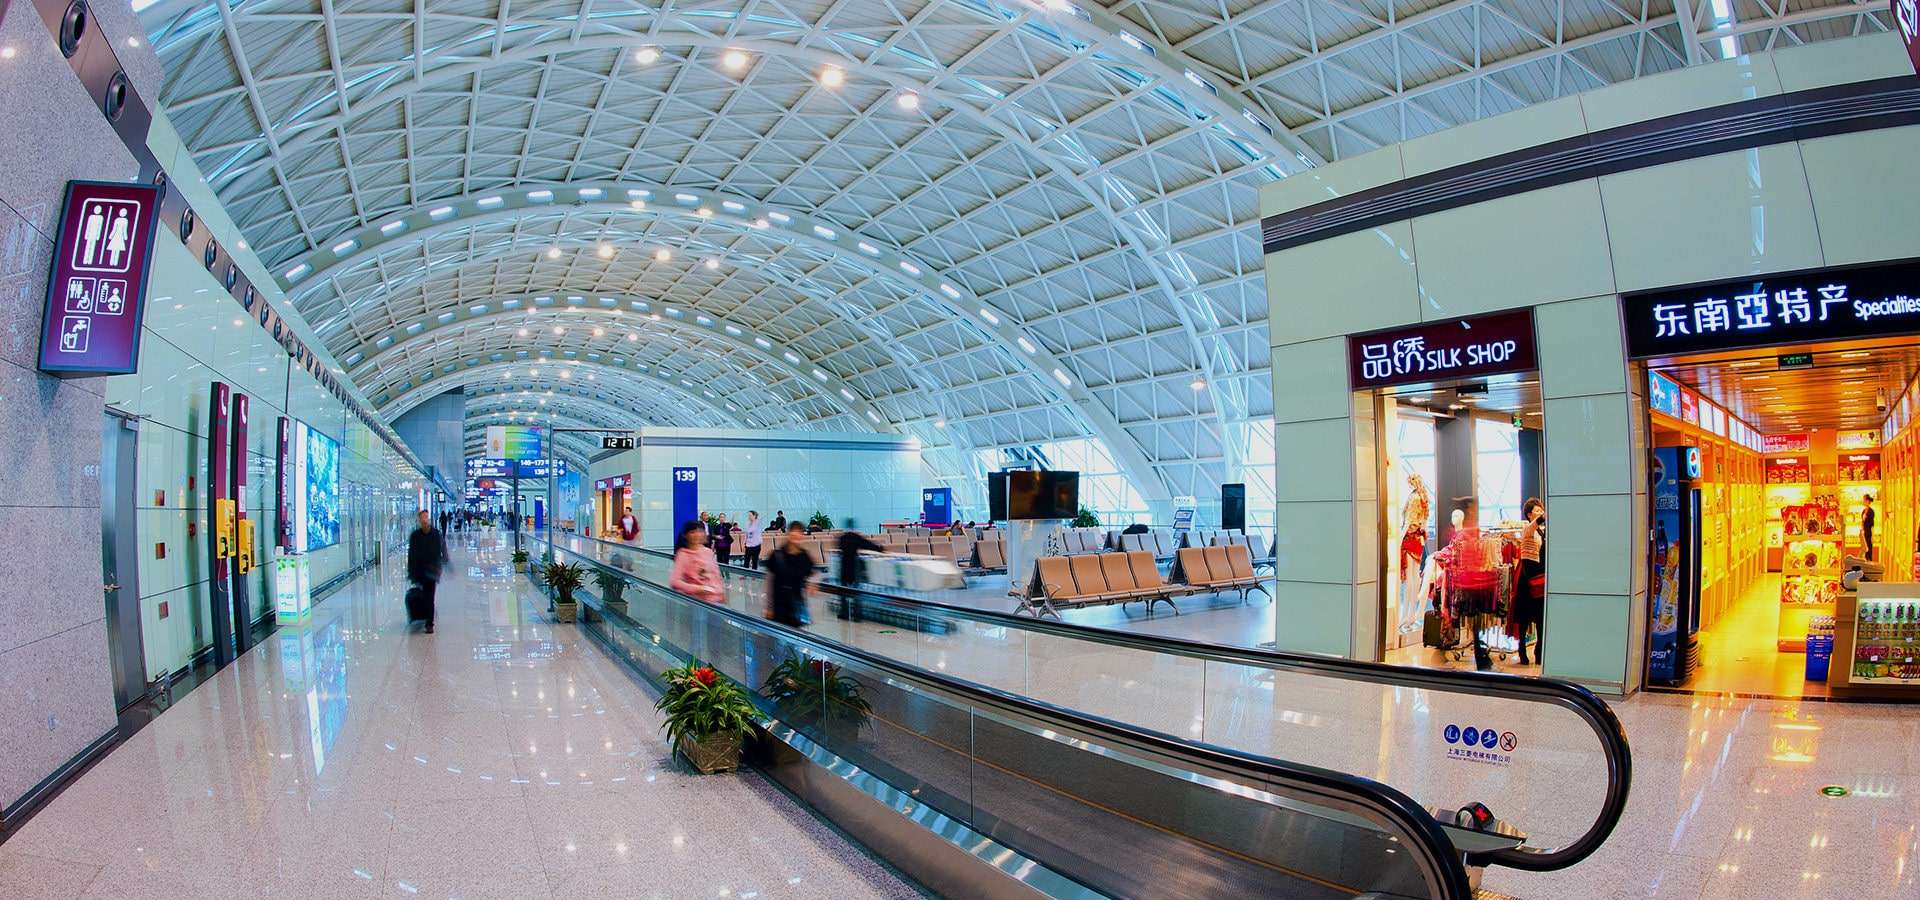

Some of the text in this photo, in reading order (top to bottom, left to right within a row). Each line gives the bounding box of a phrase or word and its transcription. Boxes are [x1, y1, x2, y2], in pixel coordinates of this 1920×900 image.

[1652, 284, 1920, 338] 东南亞特产 Specialties
[1363, 336, 1516, 379] 品绣 SILK SHOP
[606, 438, 633, 448] 12 17
[675, 470, 696, 481] 139
